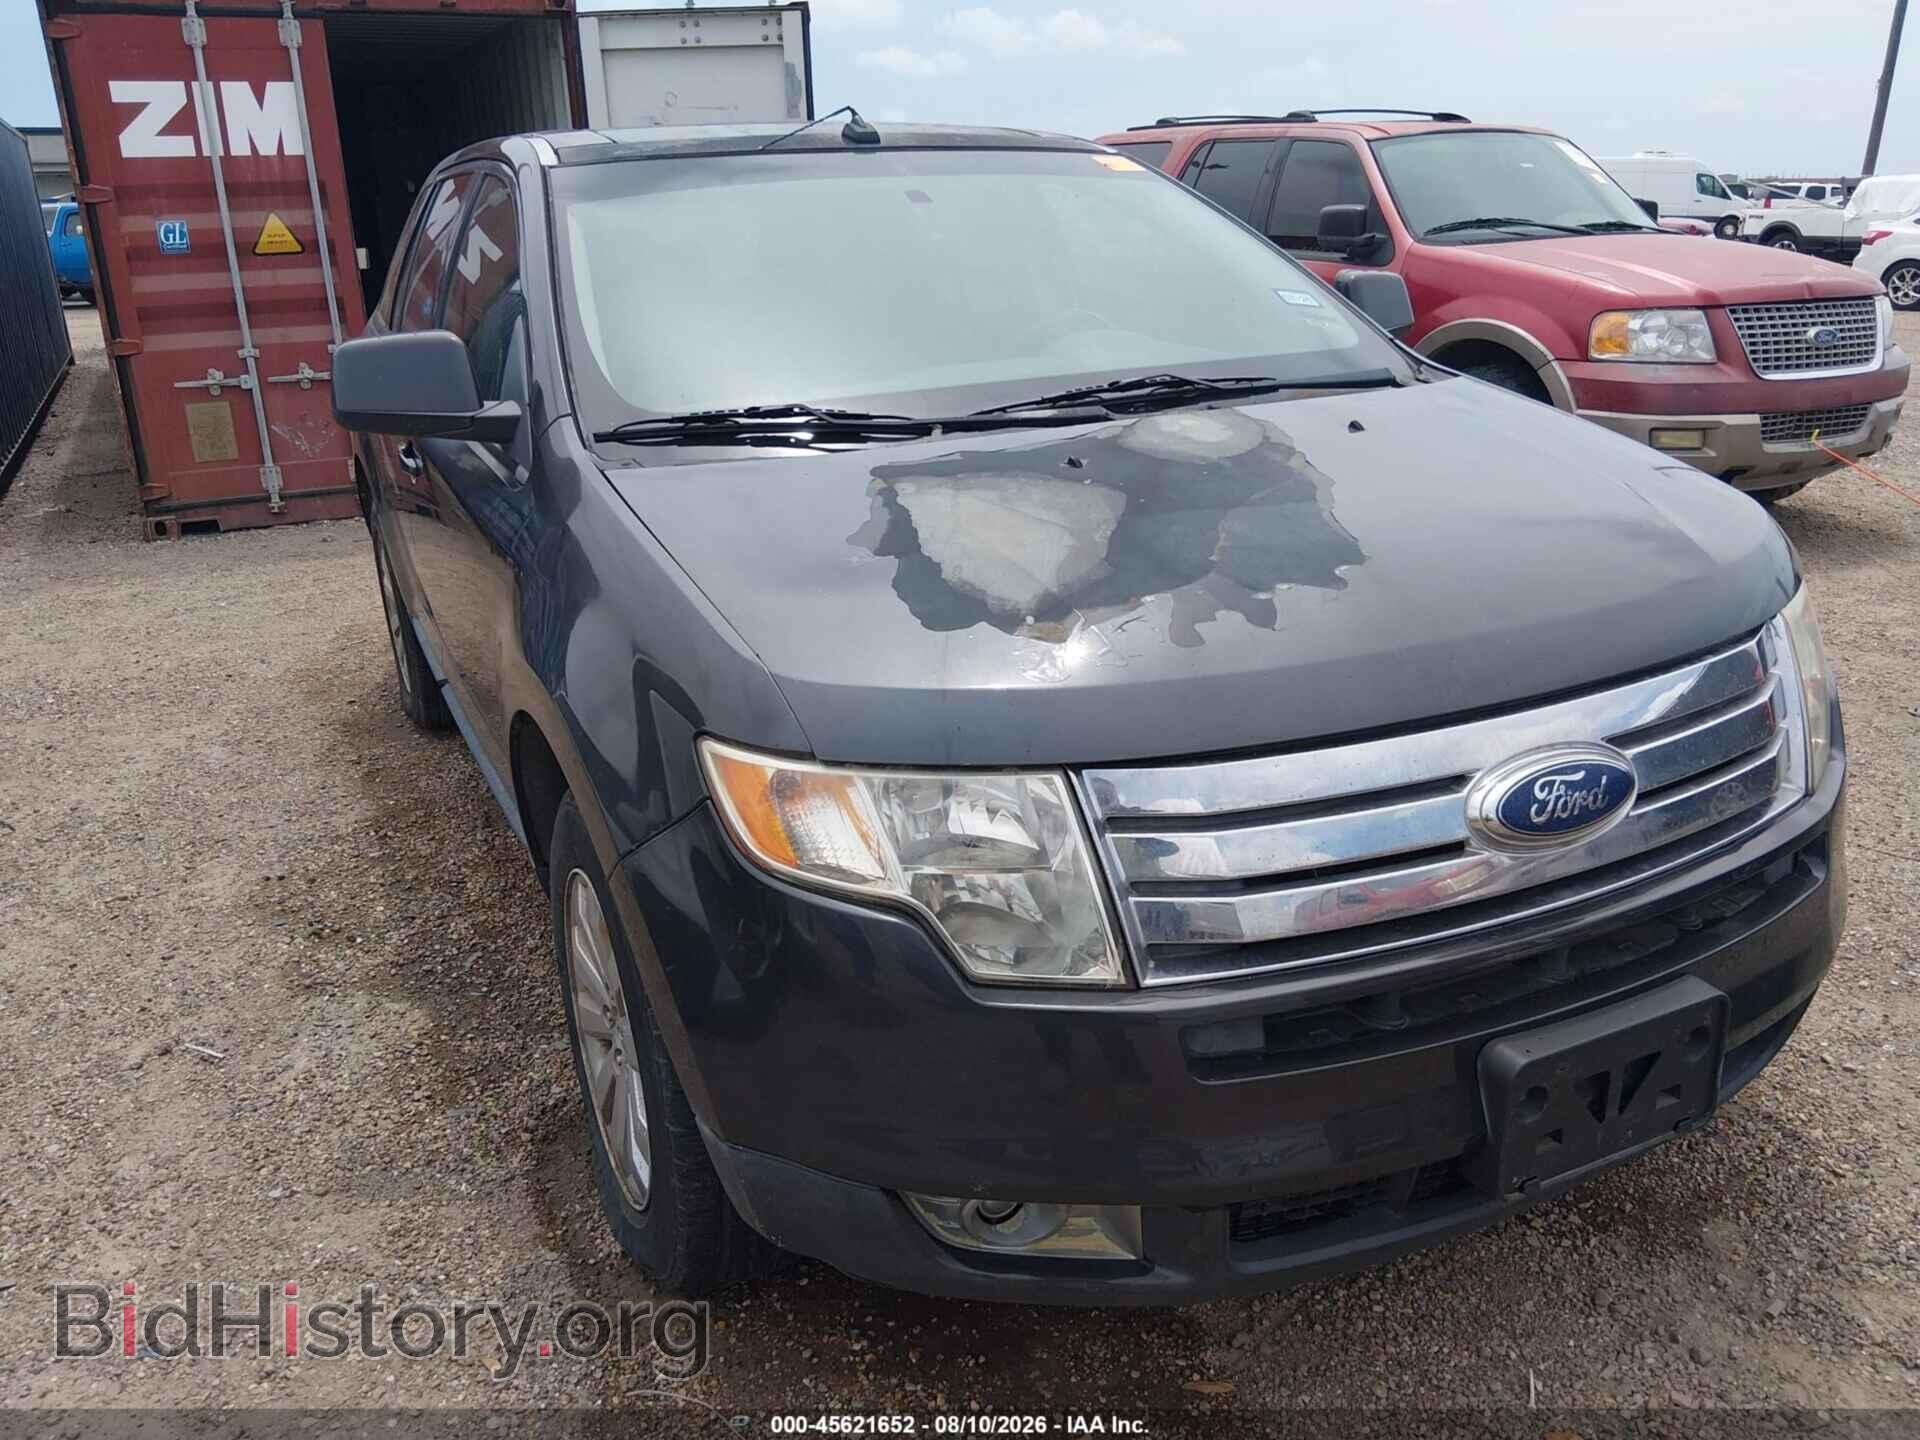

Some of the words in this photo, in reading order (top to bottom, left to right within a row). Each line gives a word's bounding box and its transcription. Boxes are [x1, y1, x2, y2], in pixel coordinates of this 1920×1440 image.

[108, 80, 305, 158] ZIM
[160, 223, 187, 244] GL
[1530, 770, 1607, 824] Ford
